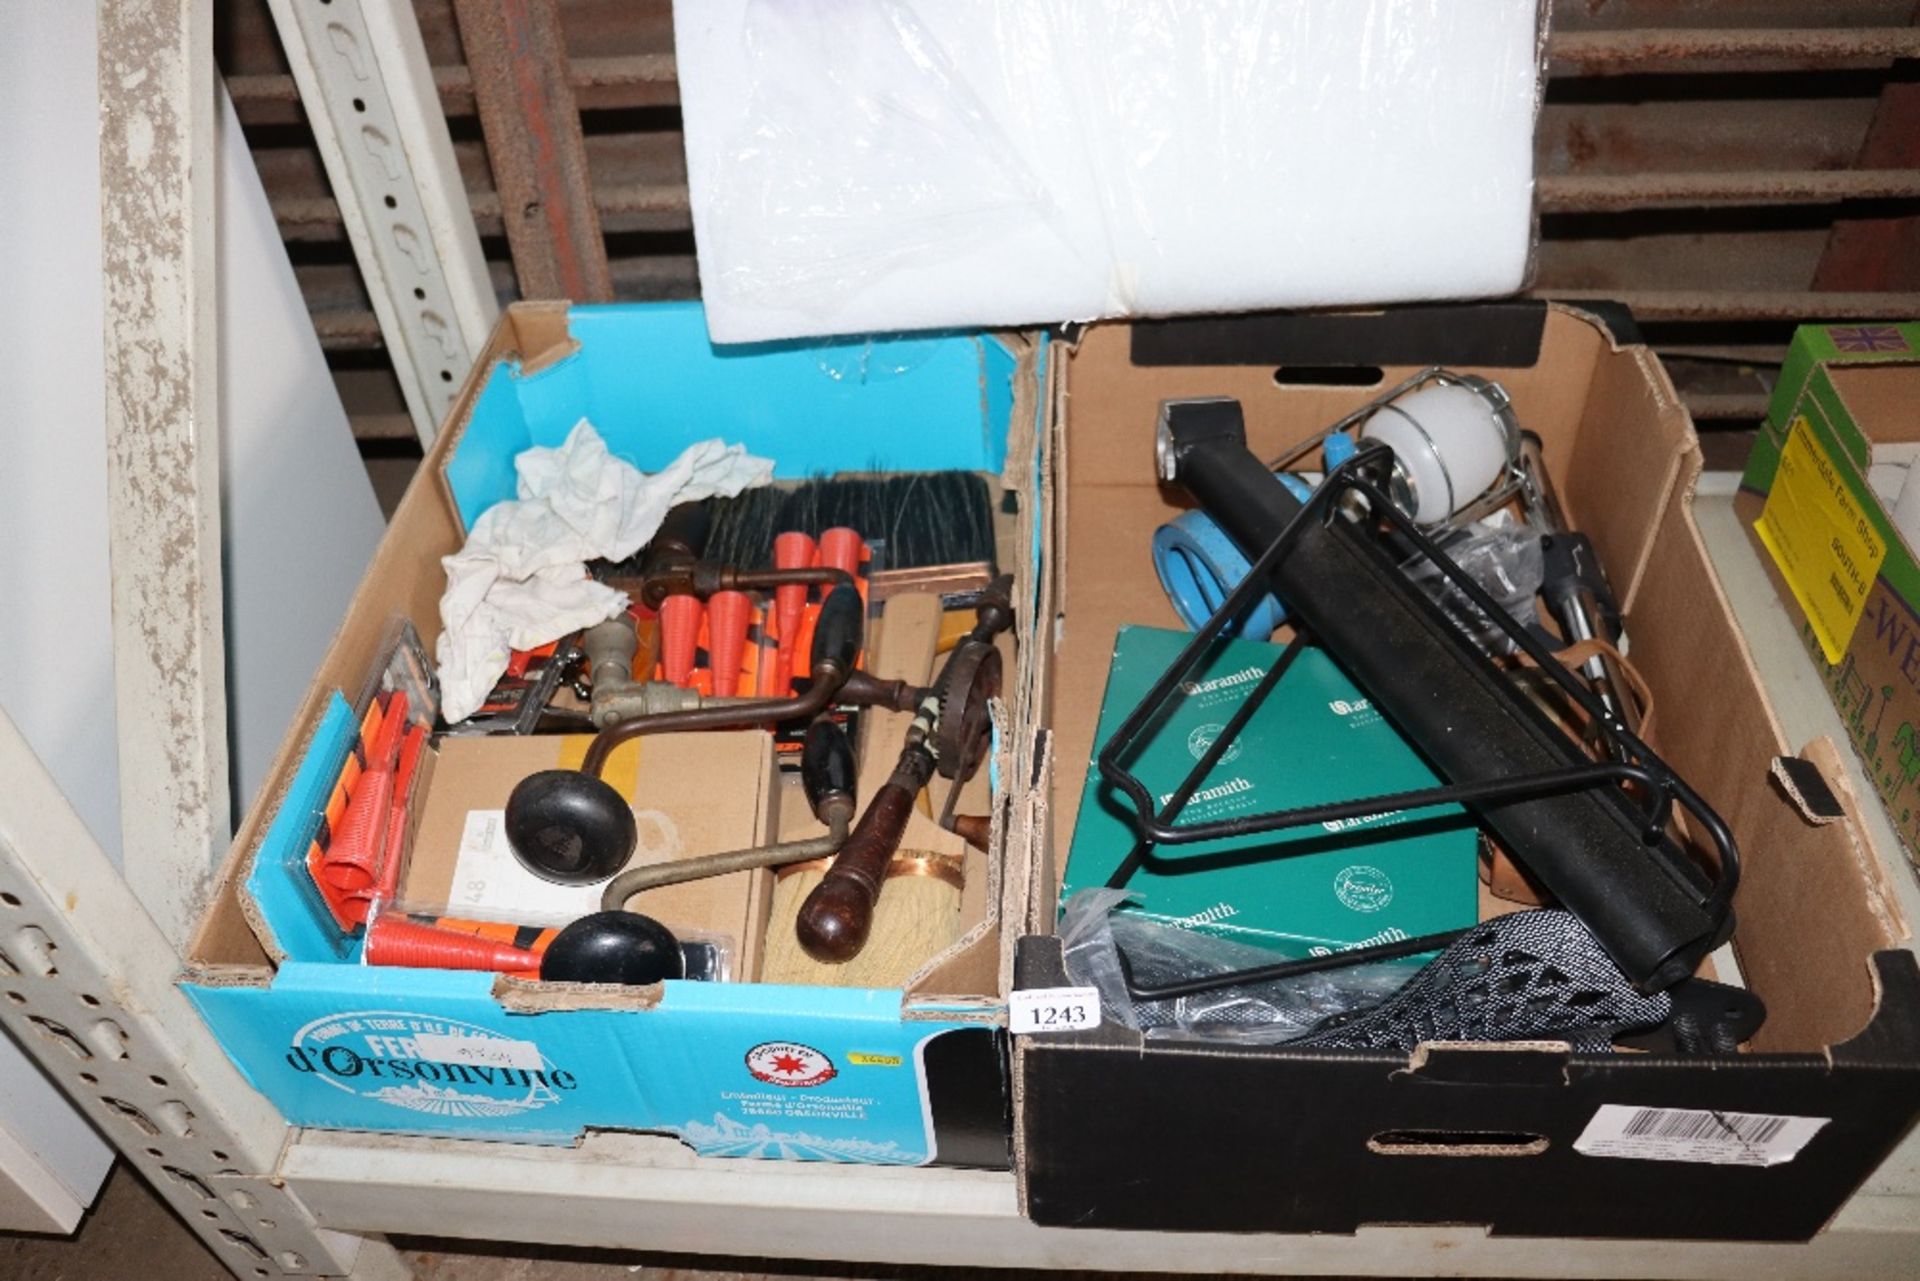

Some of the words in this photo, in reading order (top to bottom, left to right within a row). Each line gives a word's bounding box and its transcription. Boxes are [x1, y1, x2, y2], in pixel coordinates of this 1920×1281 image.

[1834, 484, 1858, 522] Farm
[1856, 518, 1879, 560] Shop
[365, 1019, 409, 1031] TERRE
[1030, 1005, 1086, 1025] 1243
